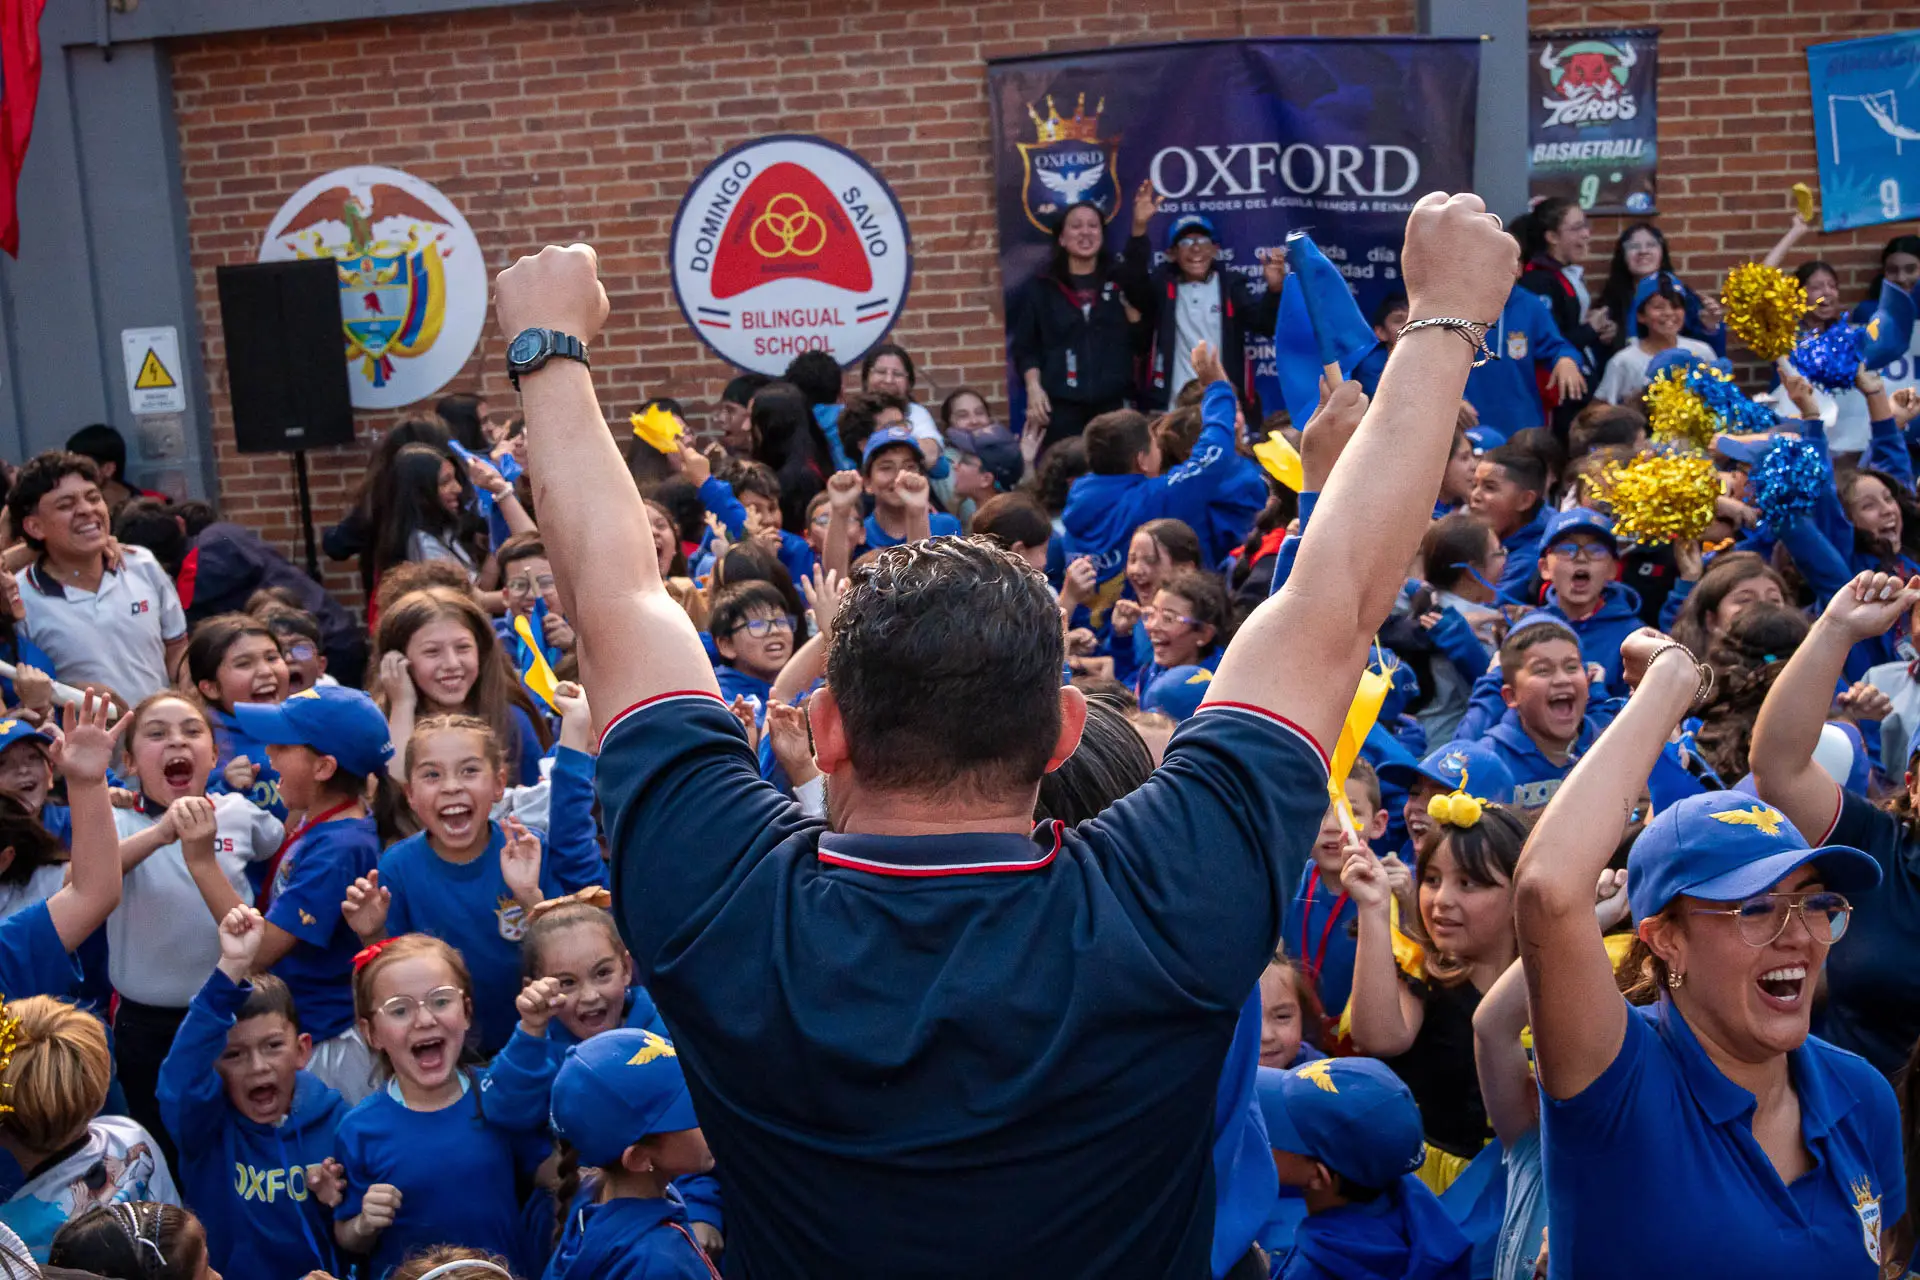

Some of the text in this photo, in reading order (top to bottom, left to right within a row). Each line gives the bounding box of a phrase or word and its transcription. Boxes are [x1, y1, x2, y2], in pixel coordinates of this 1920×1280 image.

[1541, 89, 1638, 129] TOROS
[1034, 151, 1105, 168] OXFORD
[1532, 138, 1643, 163] BASKETBALL
[1150, 142, 1420, 198] OXFORD
[1879, 178, 1900, 219] 9
[690, 160, 752, 273] DOMINGO
[842, 186, 888, 258] SAVIO
[741, 307, 846, 330] BILINGUAL
[754, 335, 836, 356] SCHOOL
